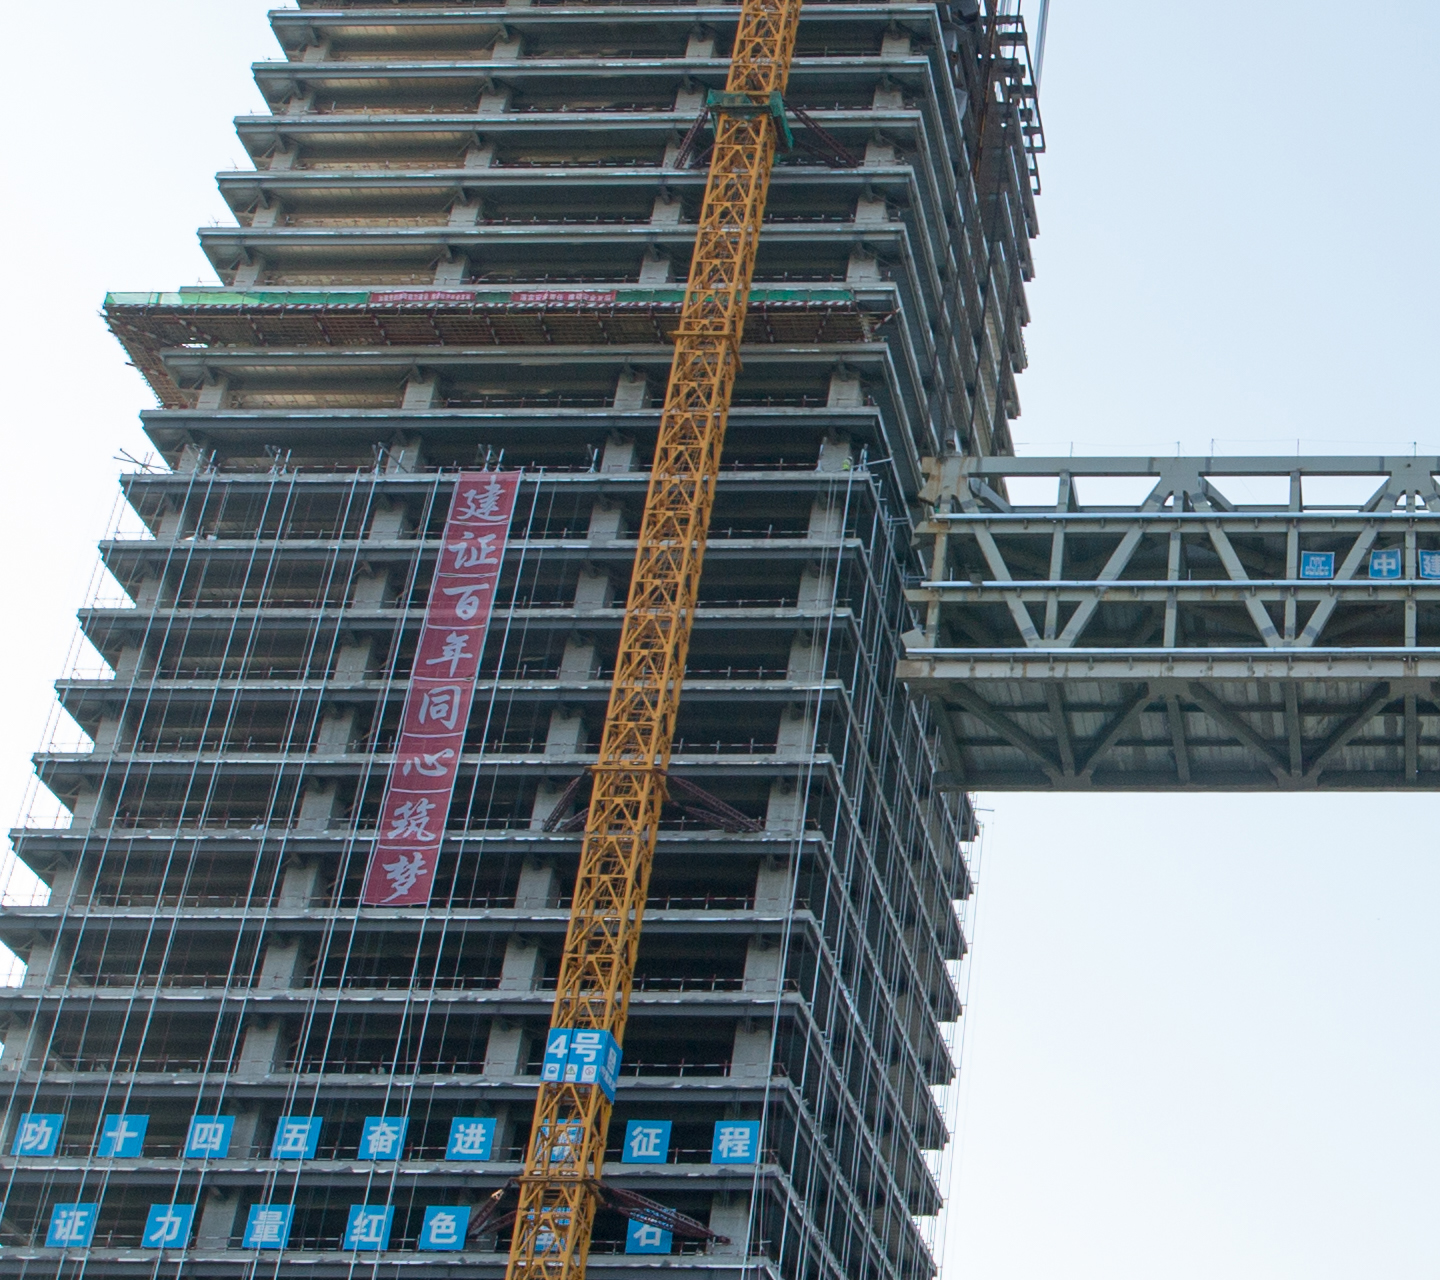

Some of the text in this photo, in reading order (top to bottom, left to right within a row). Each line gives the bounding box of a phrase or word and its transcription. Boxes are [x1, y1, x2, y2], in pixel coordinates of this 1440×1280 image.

[380, 475, 509, 903] 建证百年同心筑梦
[547, 1032, 603, 1063] 4号
